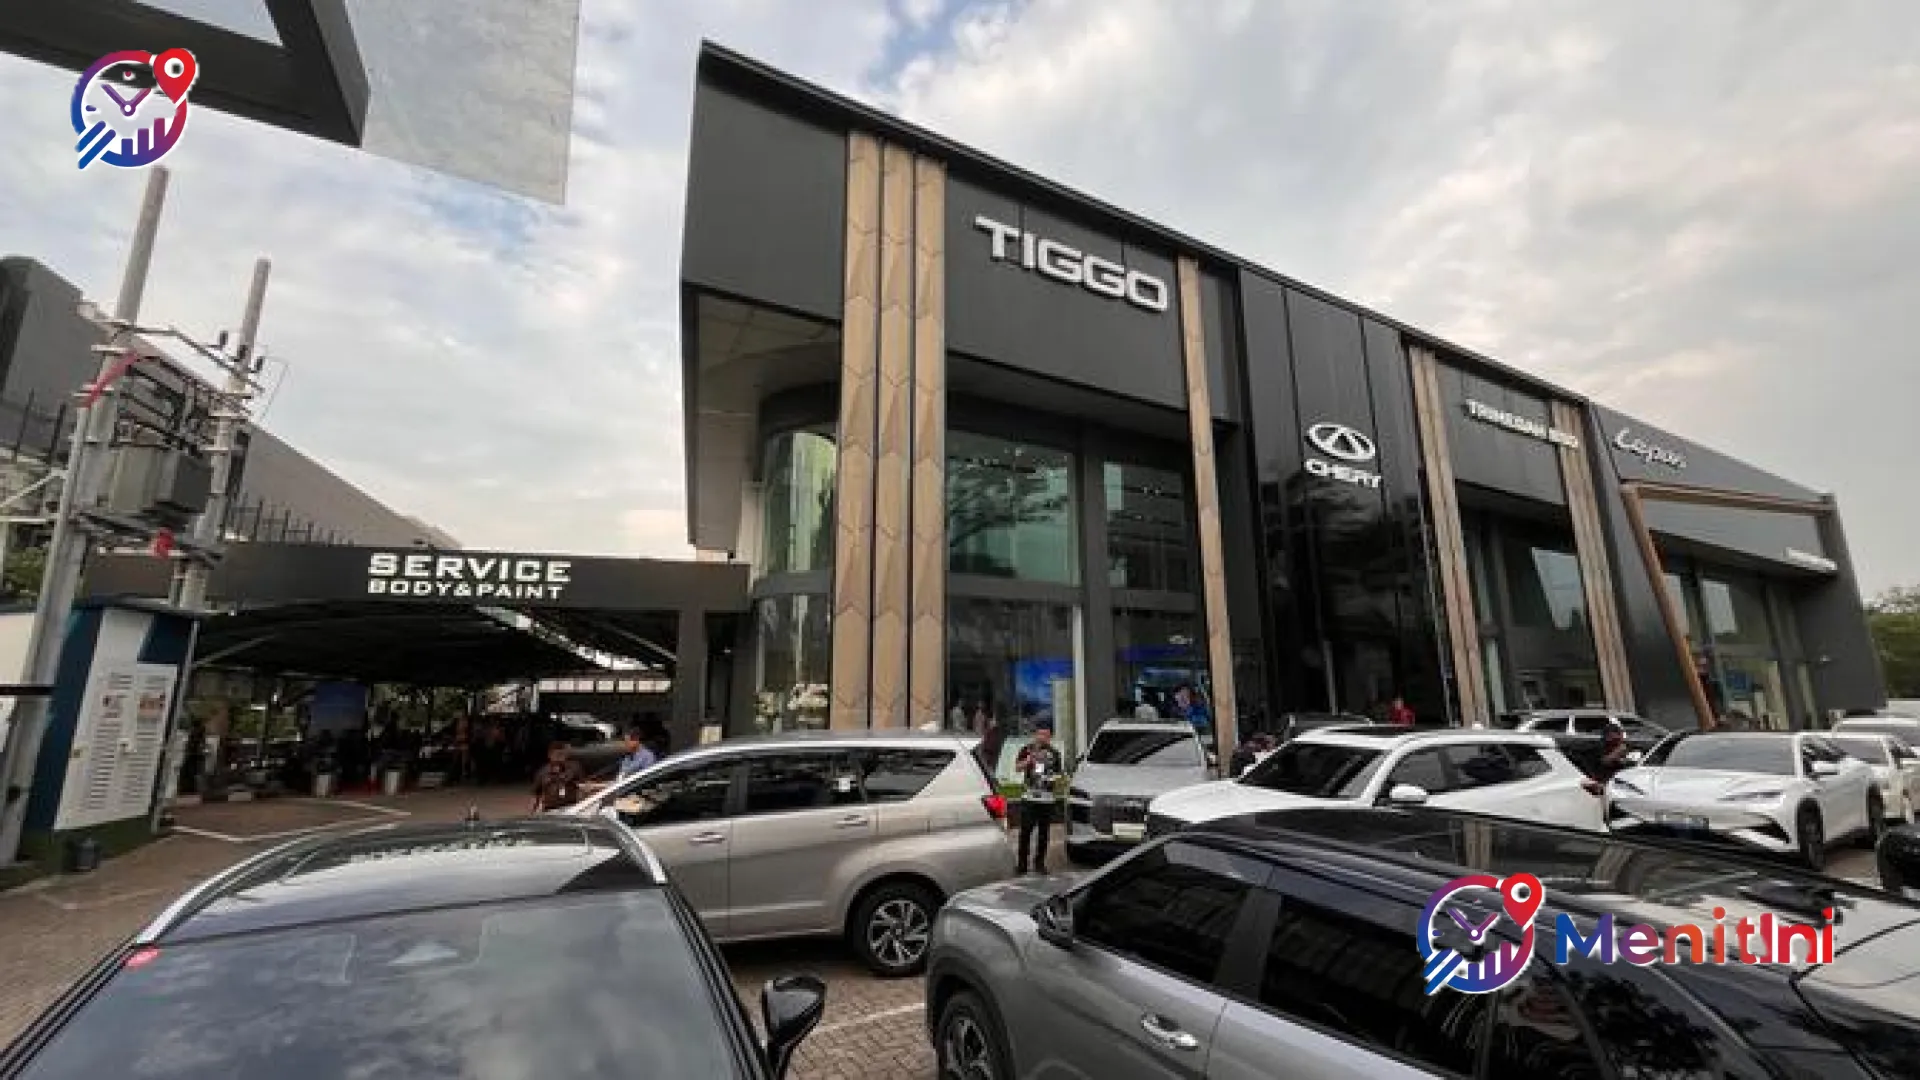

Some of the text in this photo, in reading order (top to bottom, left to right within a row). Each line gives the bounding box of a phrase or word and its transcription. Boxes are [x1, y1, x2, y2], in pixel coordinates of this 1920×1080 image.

[975, 216, 1168, 311] TIGGO
[367, 552, 571, 582] SERVICE
[367, 578, 563, 599] BODY&PAINT
